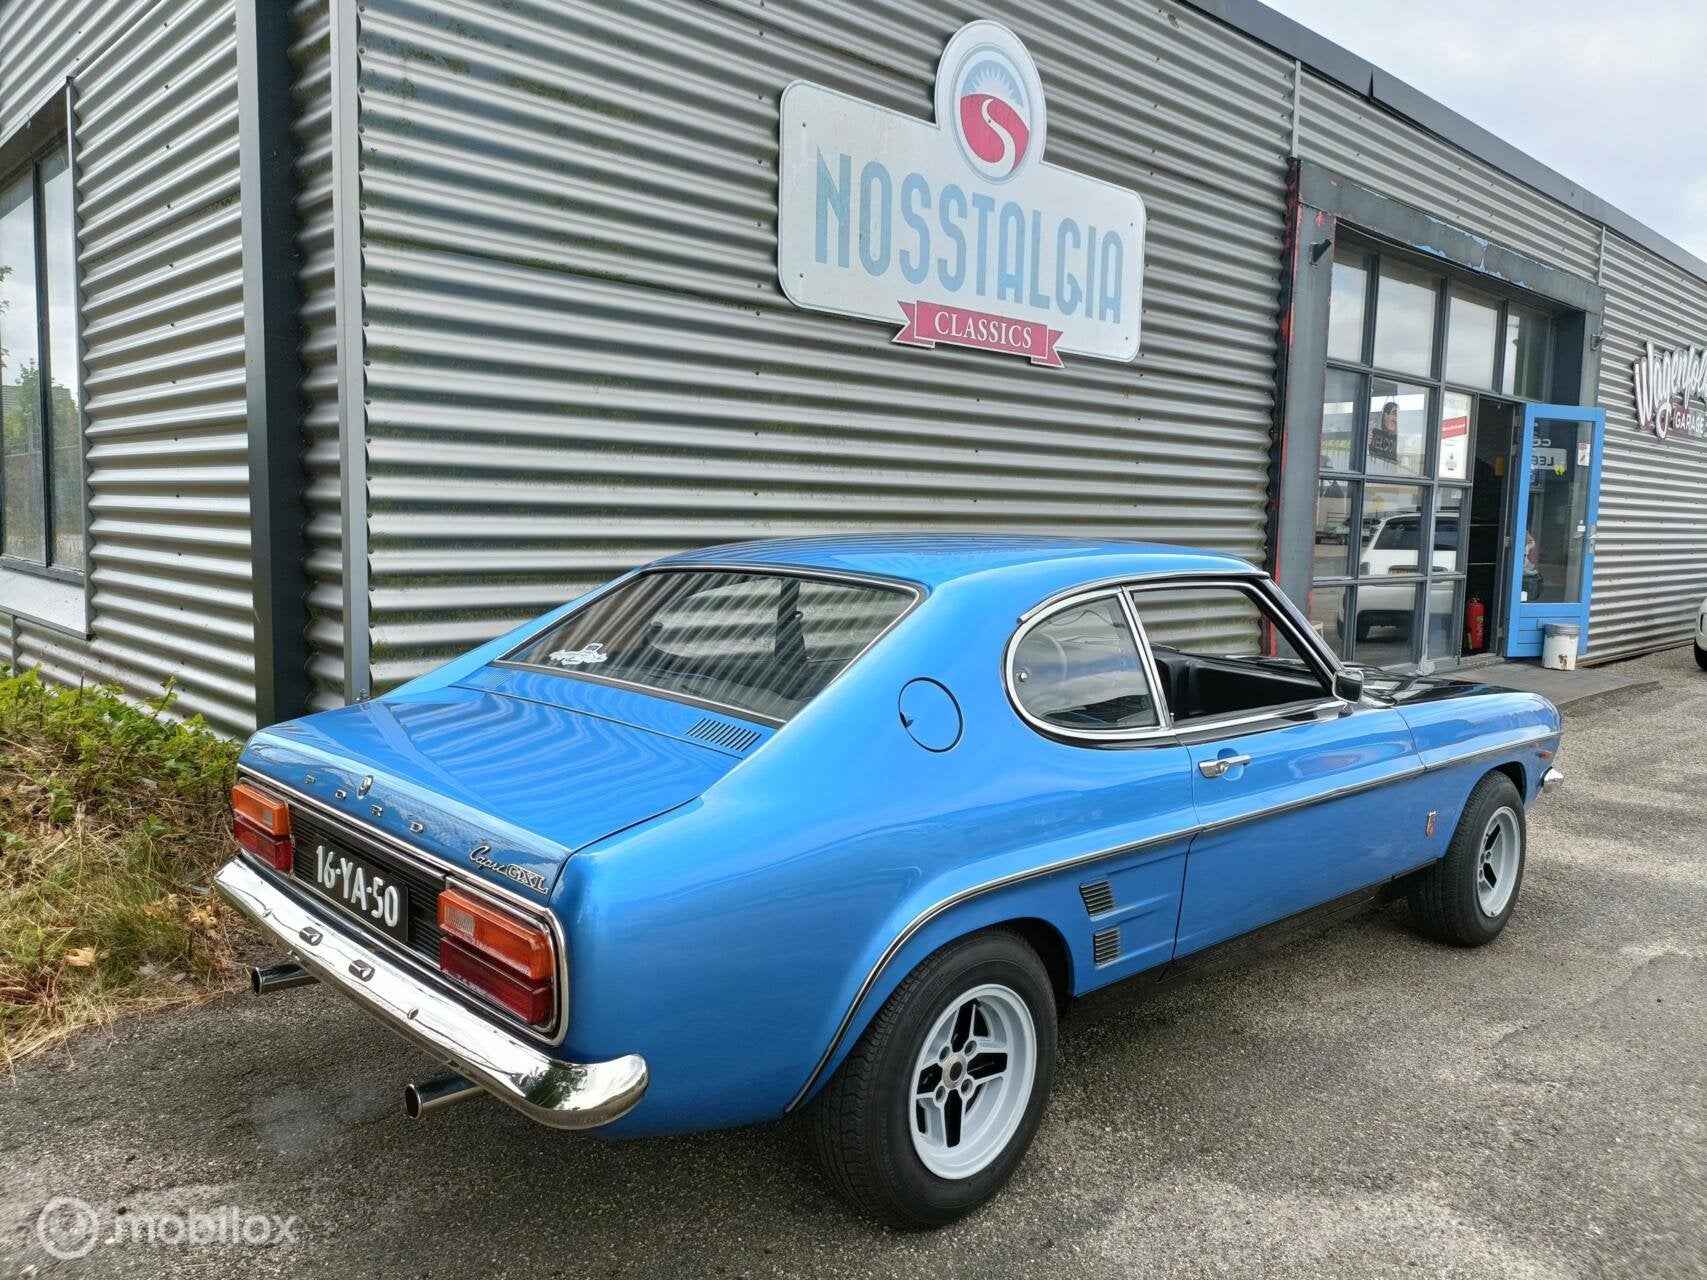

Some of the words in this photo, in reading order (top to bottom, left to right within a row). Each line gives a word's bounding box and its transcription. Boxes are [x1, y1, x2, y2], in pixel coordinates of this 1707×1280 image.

[814, 144, 1124, 325] NOSSTALGIA
[933, 310, 1033, 349] CLASSICS
[1674, 410, 1705, 434] GARAGE
[304, 774, 424, 833] FORD
[316, 845, 399, 928] 16-YA-50
[506, 863, 549, 895] GXL
